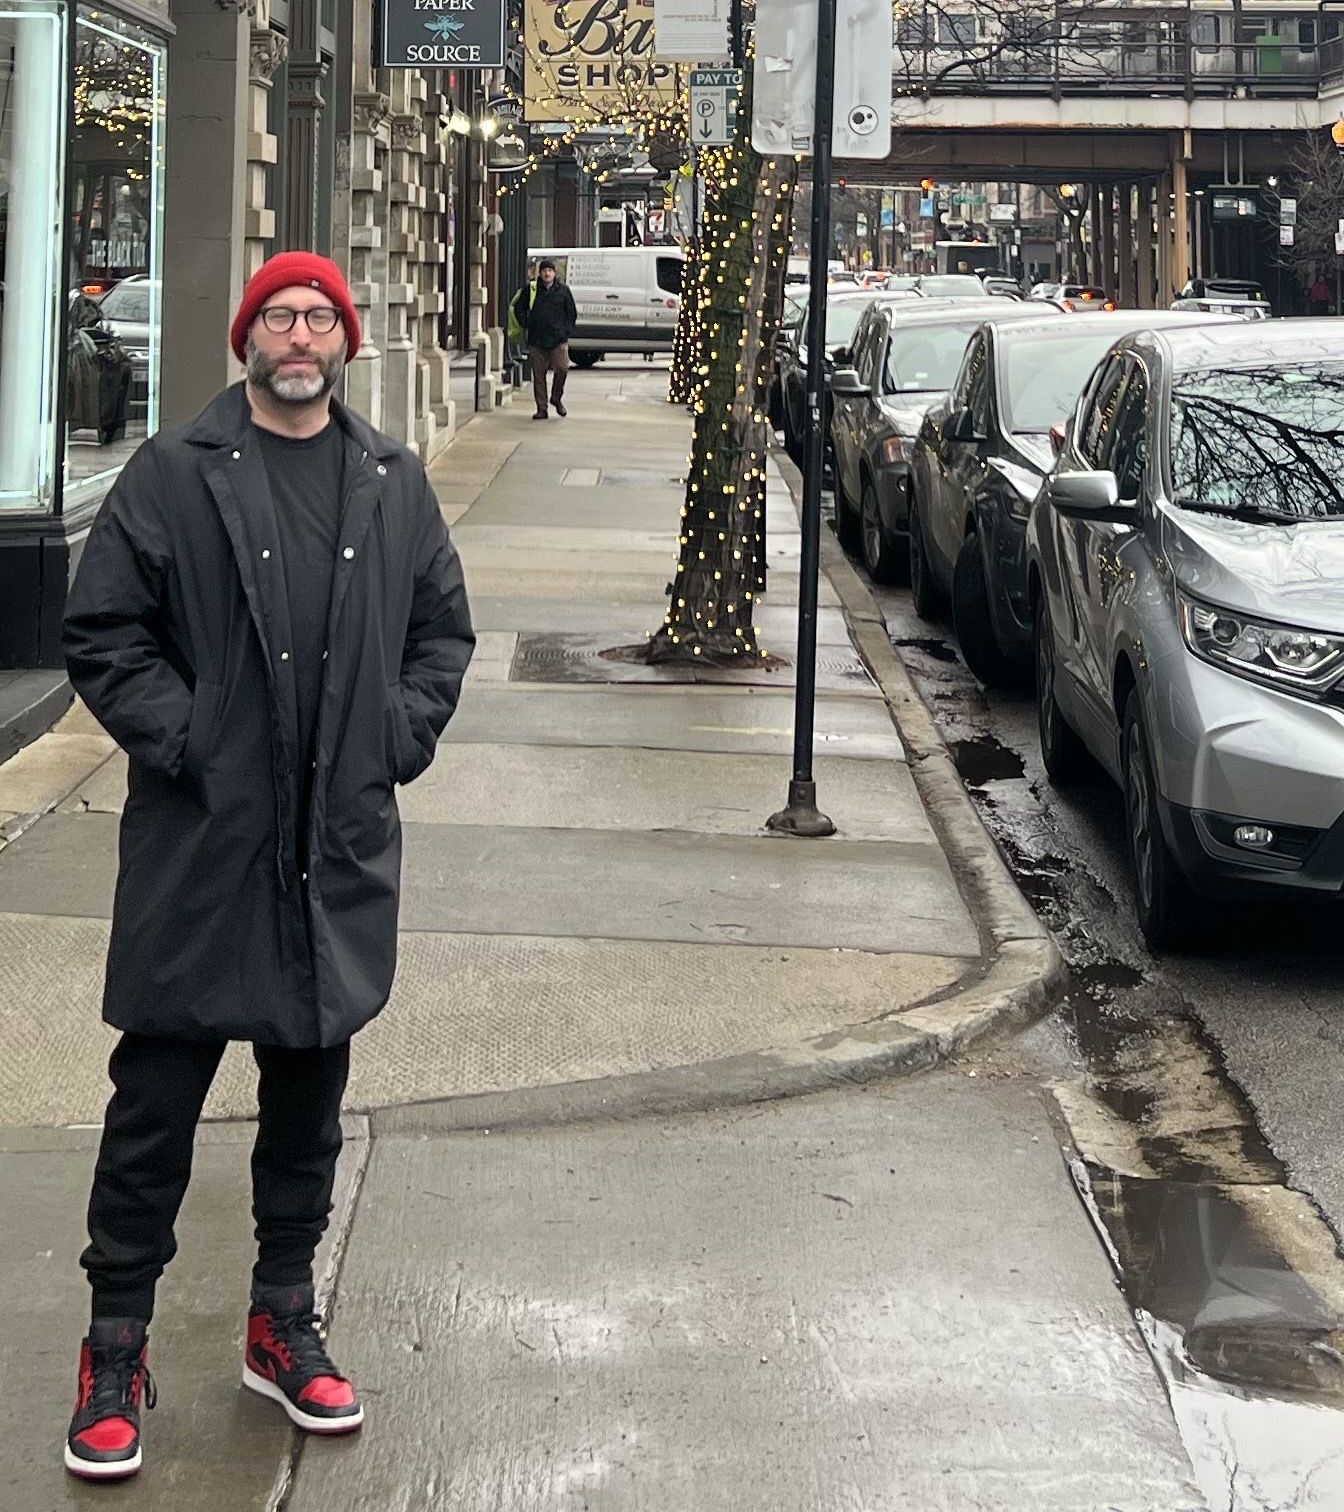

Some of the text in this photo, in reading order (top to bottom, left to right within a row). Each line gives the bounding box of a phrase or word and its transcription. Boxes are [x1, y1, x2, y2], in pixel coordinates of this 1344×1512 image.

[407, 45, 481, 62] SOURCE
[558, 63, 670, 87] SHOP
[696, 73, 743, 85] PAY TO
